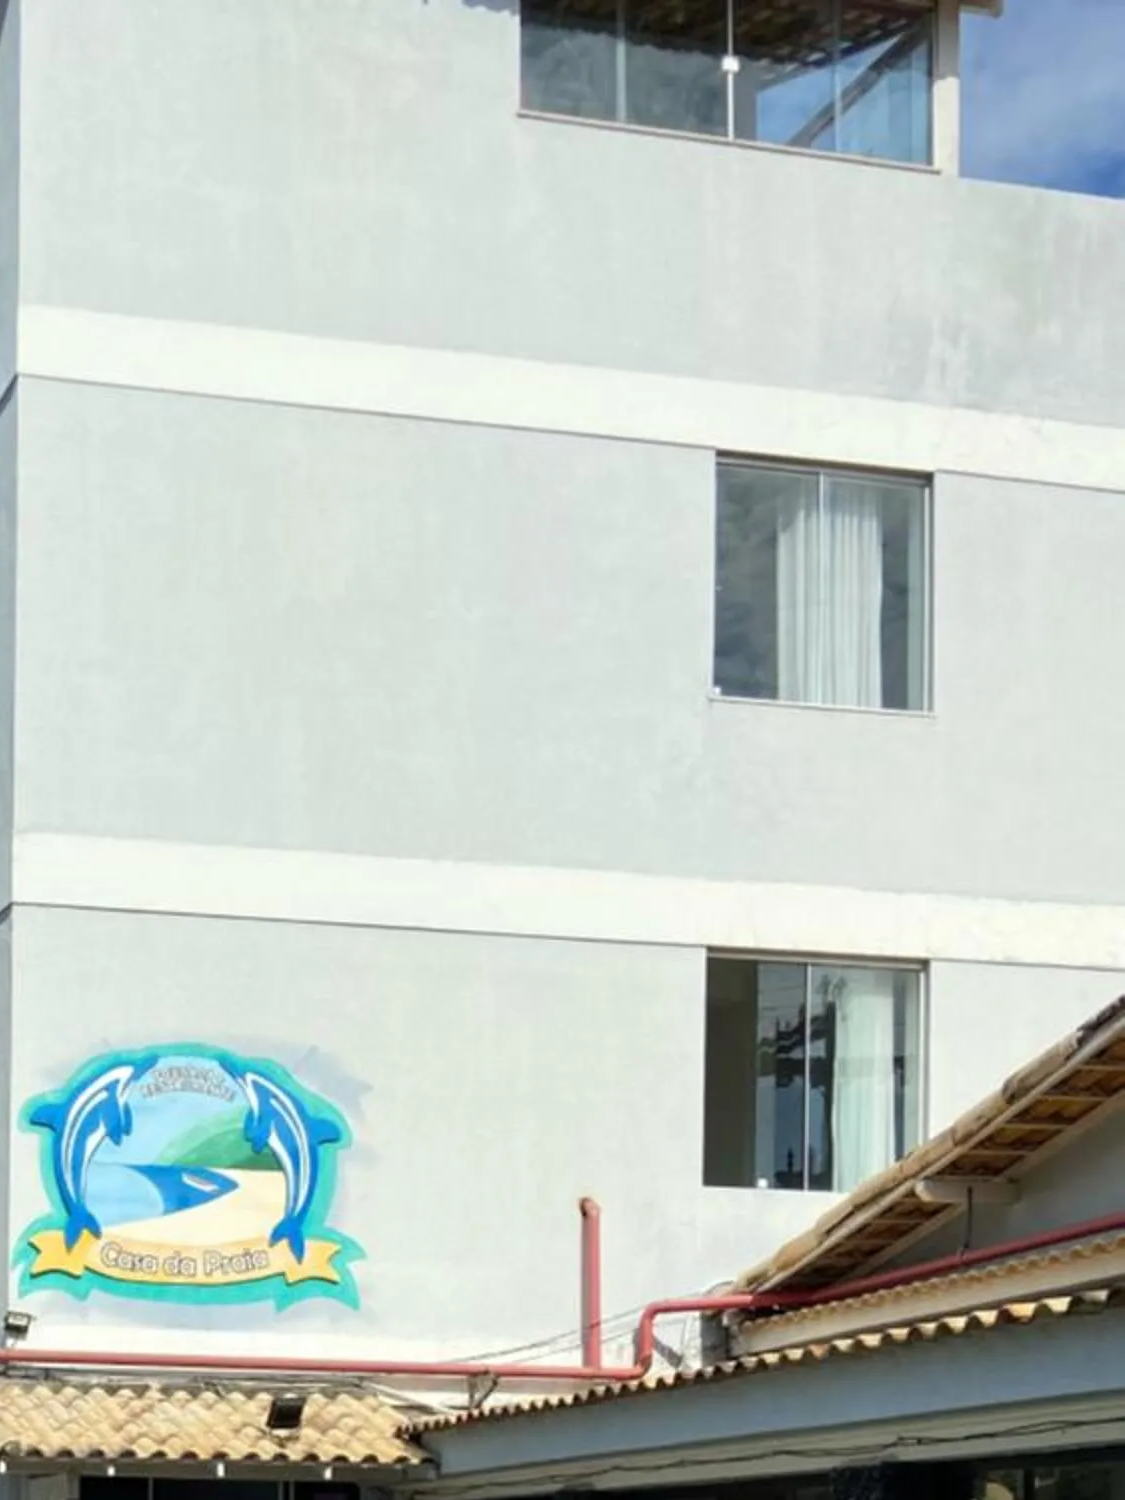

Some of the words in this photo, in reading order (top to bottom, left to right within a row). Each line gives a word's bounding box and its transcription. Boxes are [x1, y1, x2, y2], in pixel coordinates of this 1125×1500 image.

[101, 1242, 159, 1274] Casa
[162, 1250, 198, 1278] da
[203, 1249, 268, 1276] Praia
